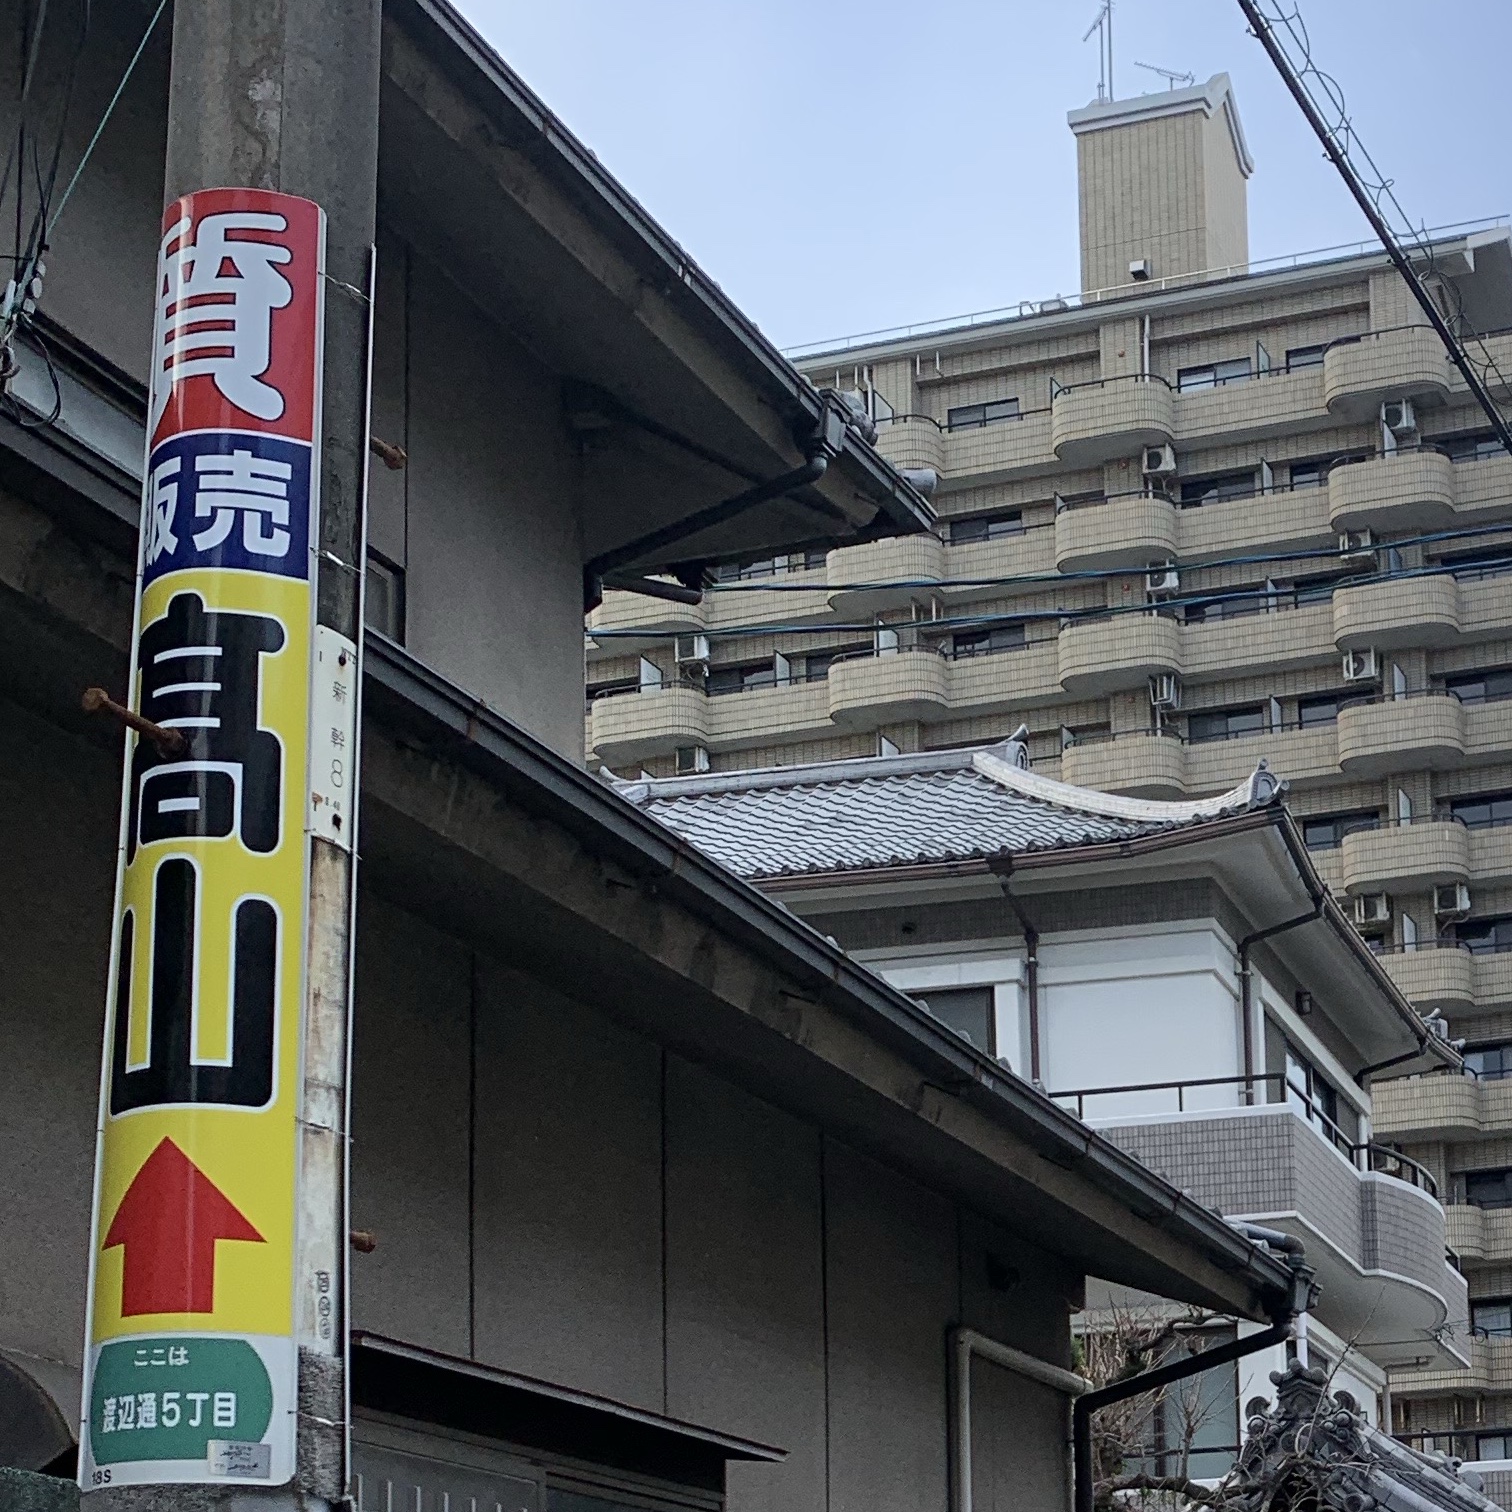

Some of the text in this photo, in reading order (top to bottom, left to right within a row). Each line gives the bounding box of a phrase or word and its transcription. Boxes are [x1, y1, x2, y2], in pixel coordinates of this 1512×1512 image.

[134, 1346, 189, 1367] ここは
[91, 1469, 112, 1484] 18S
